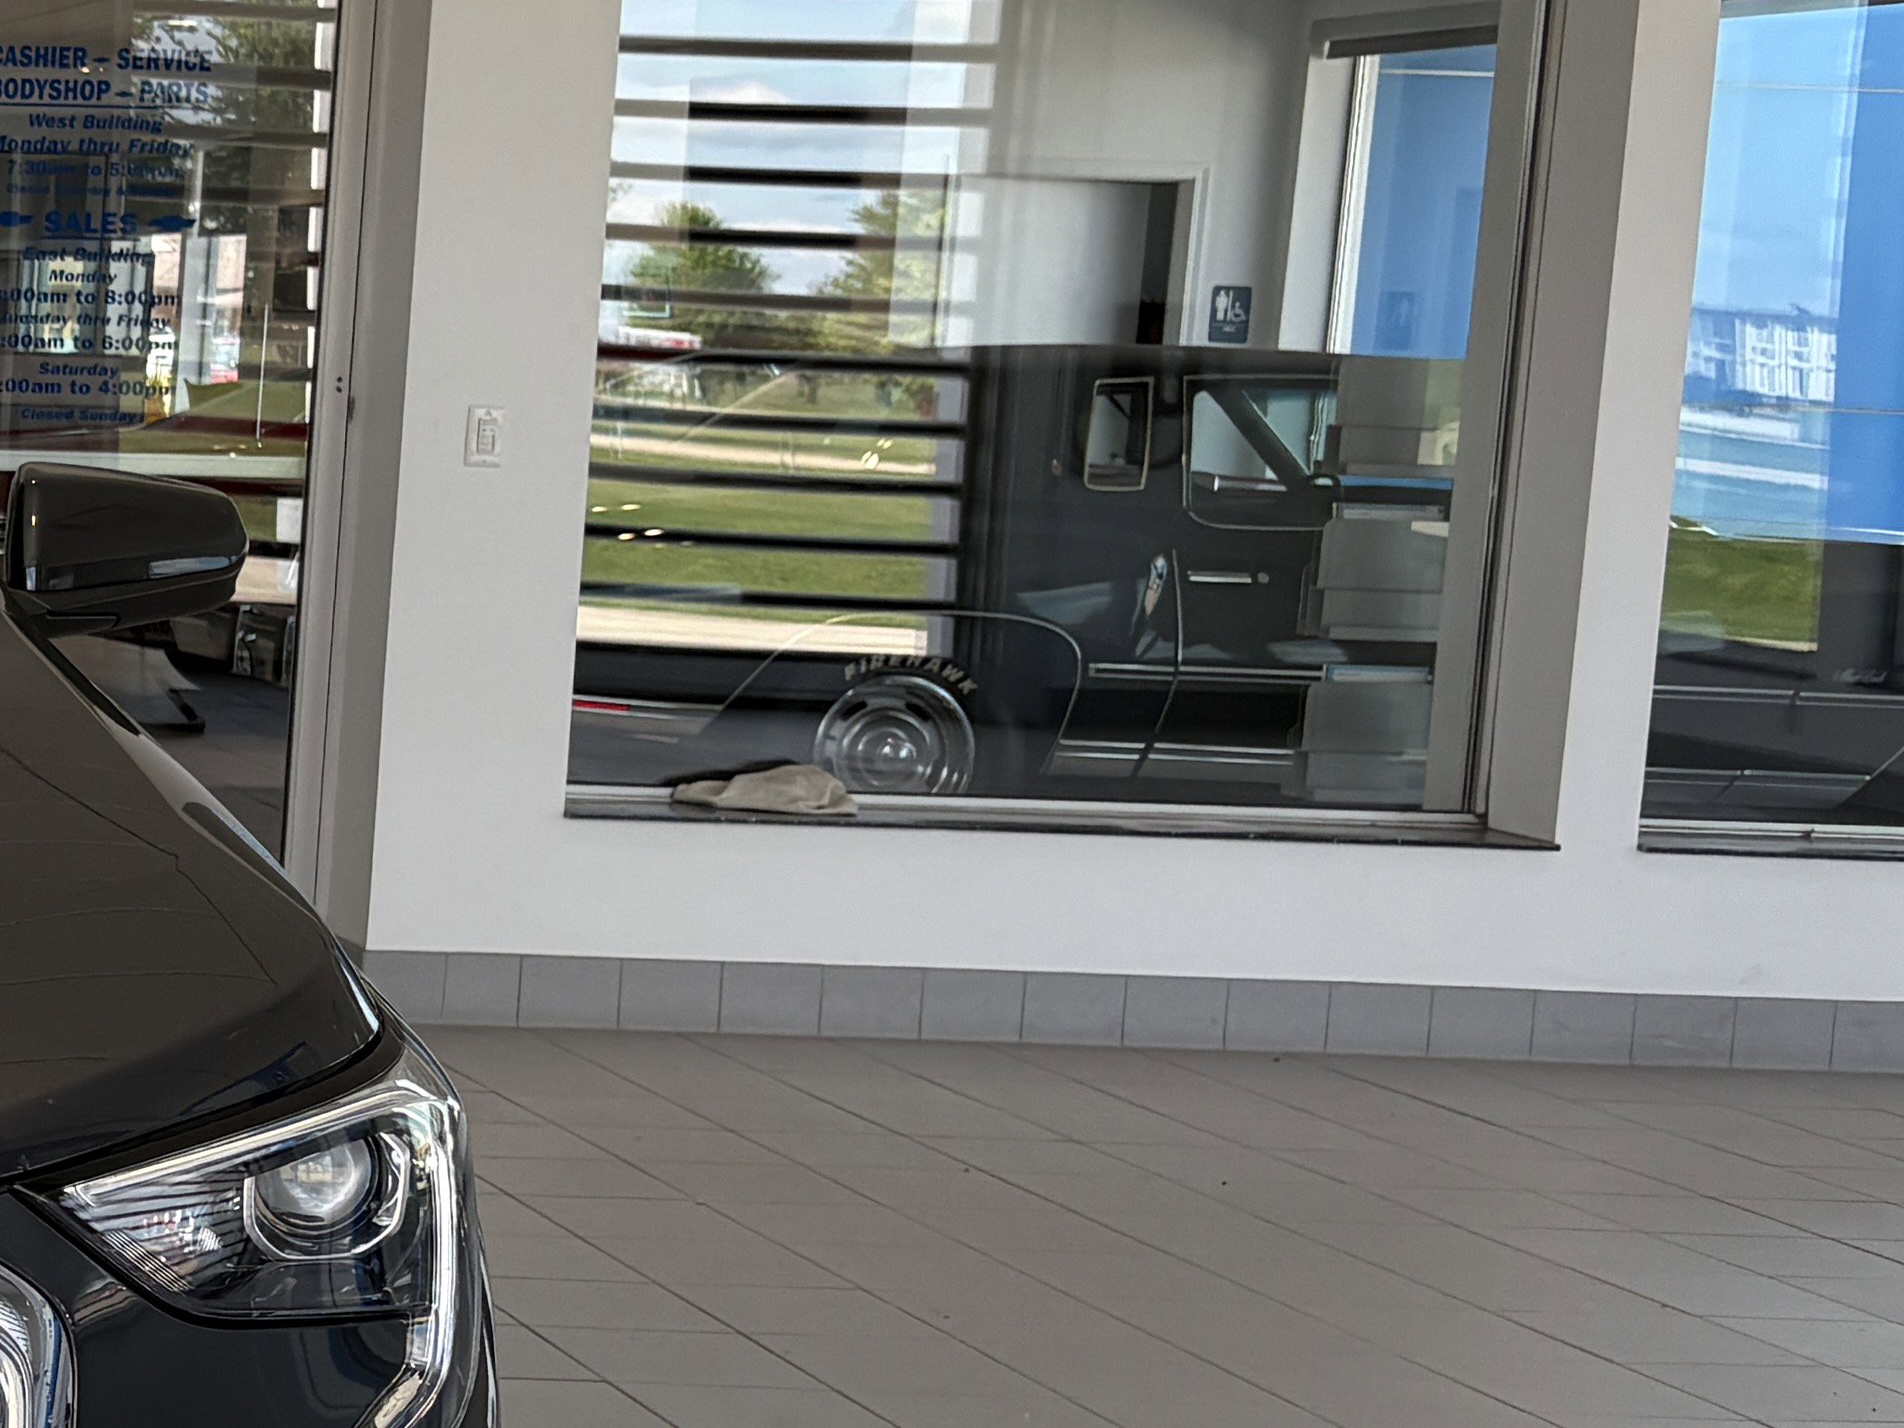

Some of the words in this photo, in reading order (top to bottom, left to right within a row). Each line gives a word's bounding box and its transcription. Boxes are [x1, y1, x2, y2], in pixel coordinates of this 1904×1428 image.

[116, 48, 213, 72] SERVICE
[138, 80, 210, 104] PARTS
[29, 113, 77, 129] West
[83, 114, 163, 134] Building
[78, 136, 120, 154] thru
[127, 138, 194, 158] Friday
[44, 211, 138, 234] SALES
[24, 246, 68, 261] East
[49, 269, 118, 286] Monday
[76, 290, 97, 305] to
[77, 313, 111, 326] thru
[74, 334, 95, 350] to
[39, 362, 120, 379] Saturday
[71, 379, 91, 395] to
